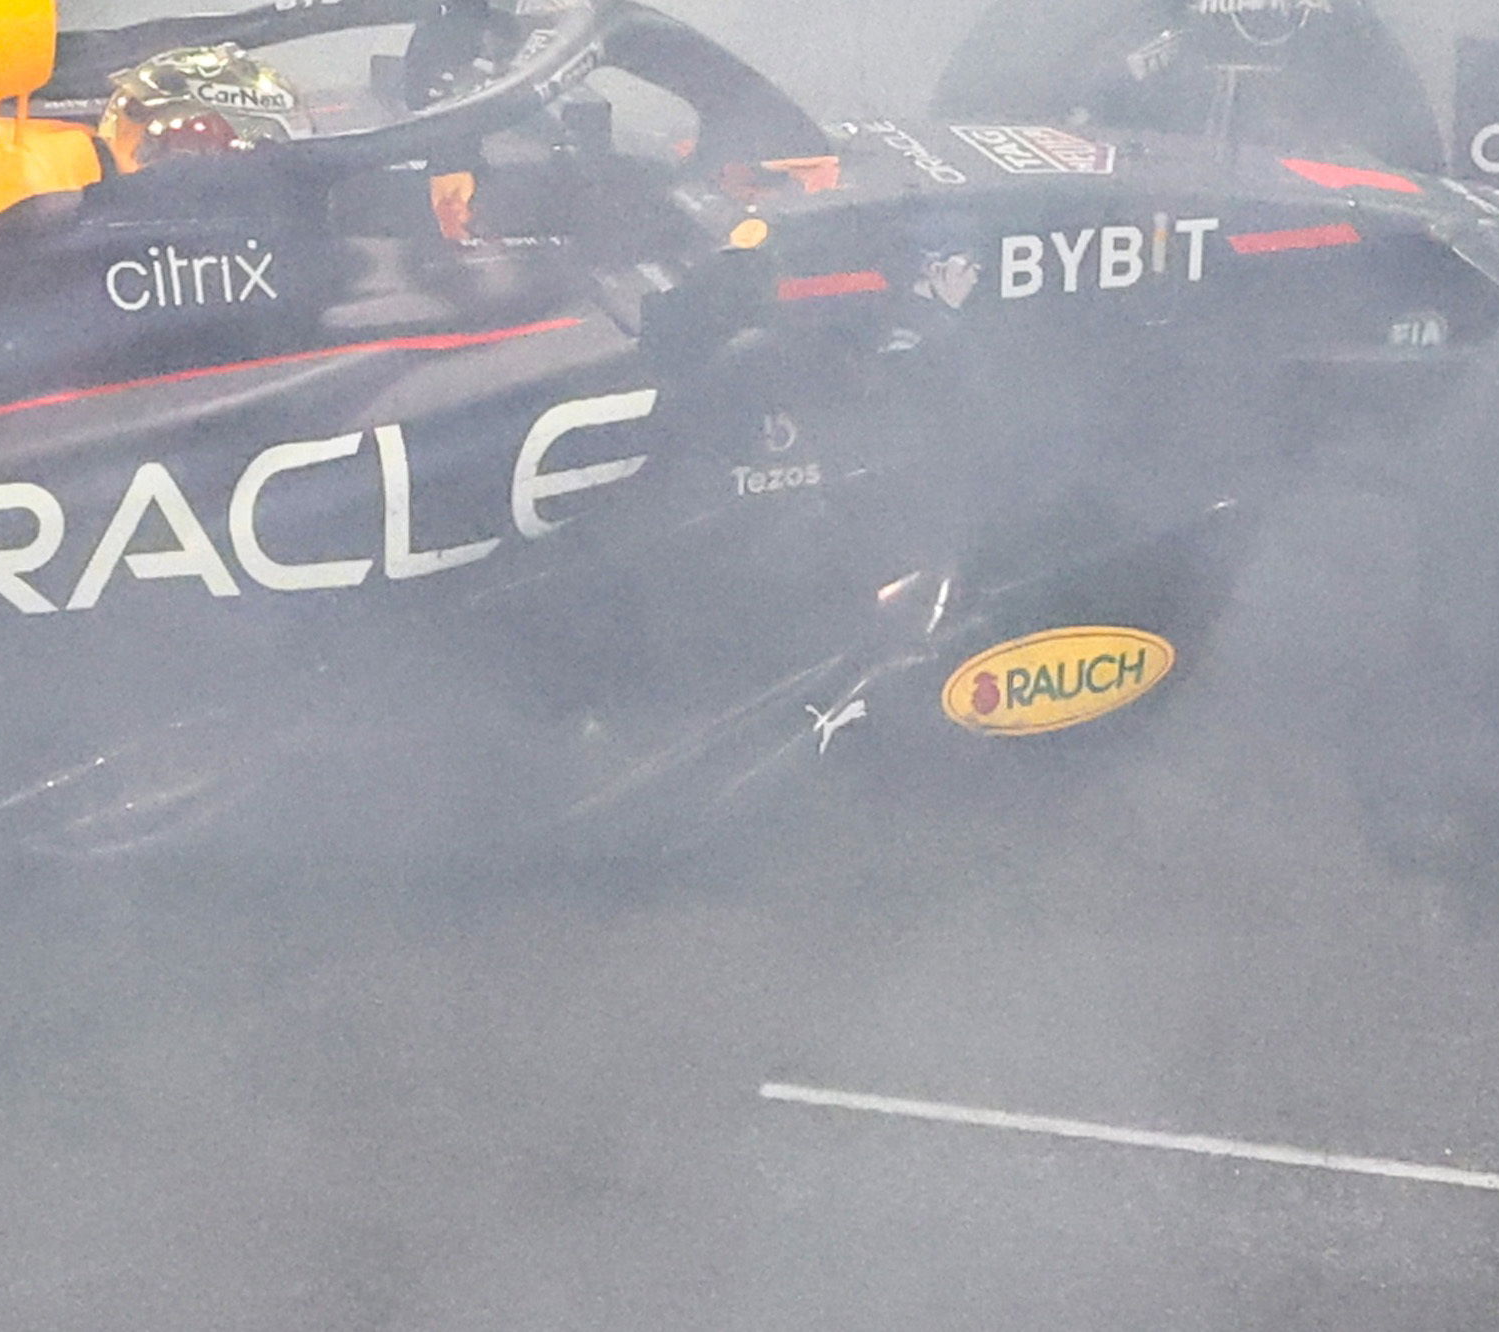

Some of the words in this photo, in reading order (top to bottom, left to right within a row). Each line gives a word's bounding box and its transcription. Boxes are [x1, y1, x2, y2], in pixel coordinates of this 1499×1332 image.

[199, 84, 287, 109] CarNext
[105, 237, 279, 312] citrix
[1000, 211, 1221, 301] BYBIT
[731, 463, 822, 496] Tezos
[1006, 647, 1146, 708] RAUCH
